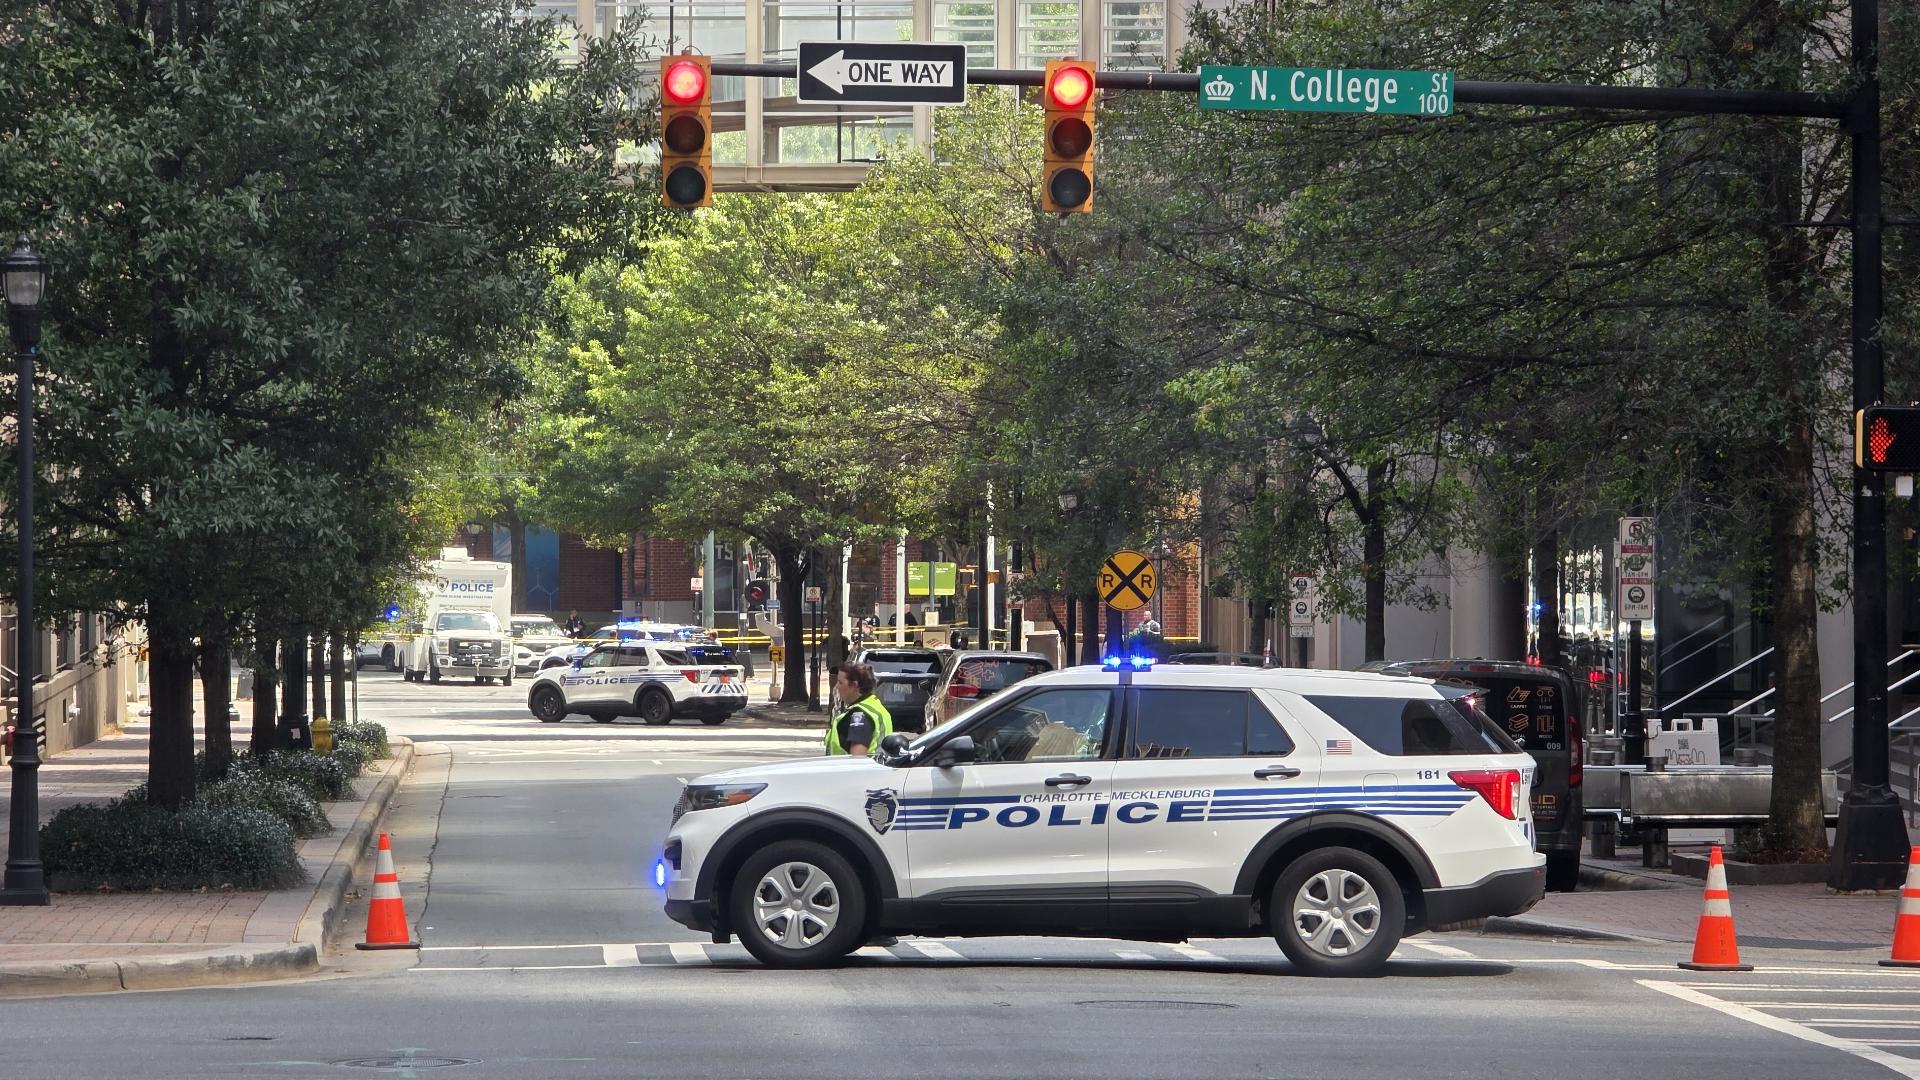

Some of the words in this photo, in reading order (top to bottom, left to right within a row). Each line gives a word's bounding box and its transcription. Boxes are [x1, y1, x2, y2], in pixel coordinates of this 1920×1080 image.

[849, 62, 892, 83] ONE
[902, 63, 947, 84] WAY
[1250, 69, 1277, 101] N.
[1290, 69, 1398, 113] College
[1431, 72, 1448, 93] St
[1418, 93, 1449, 114] 100
[451, 583, 494, 593] POLICE
[1102, 573, 1115, 588] R
[1140, 573, 1153, 589] R
[576, 677, 629, 686] POLICE
[1546, 742, 1561, 750] 009
[1416, 769, 1440, 780] 181
[947, 800, 1214, 830] POLICE
